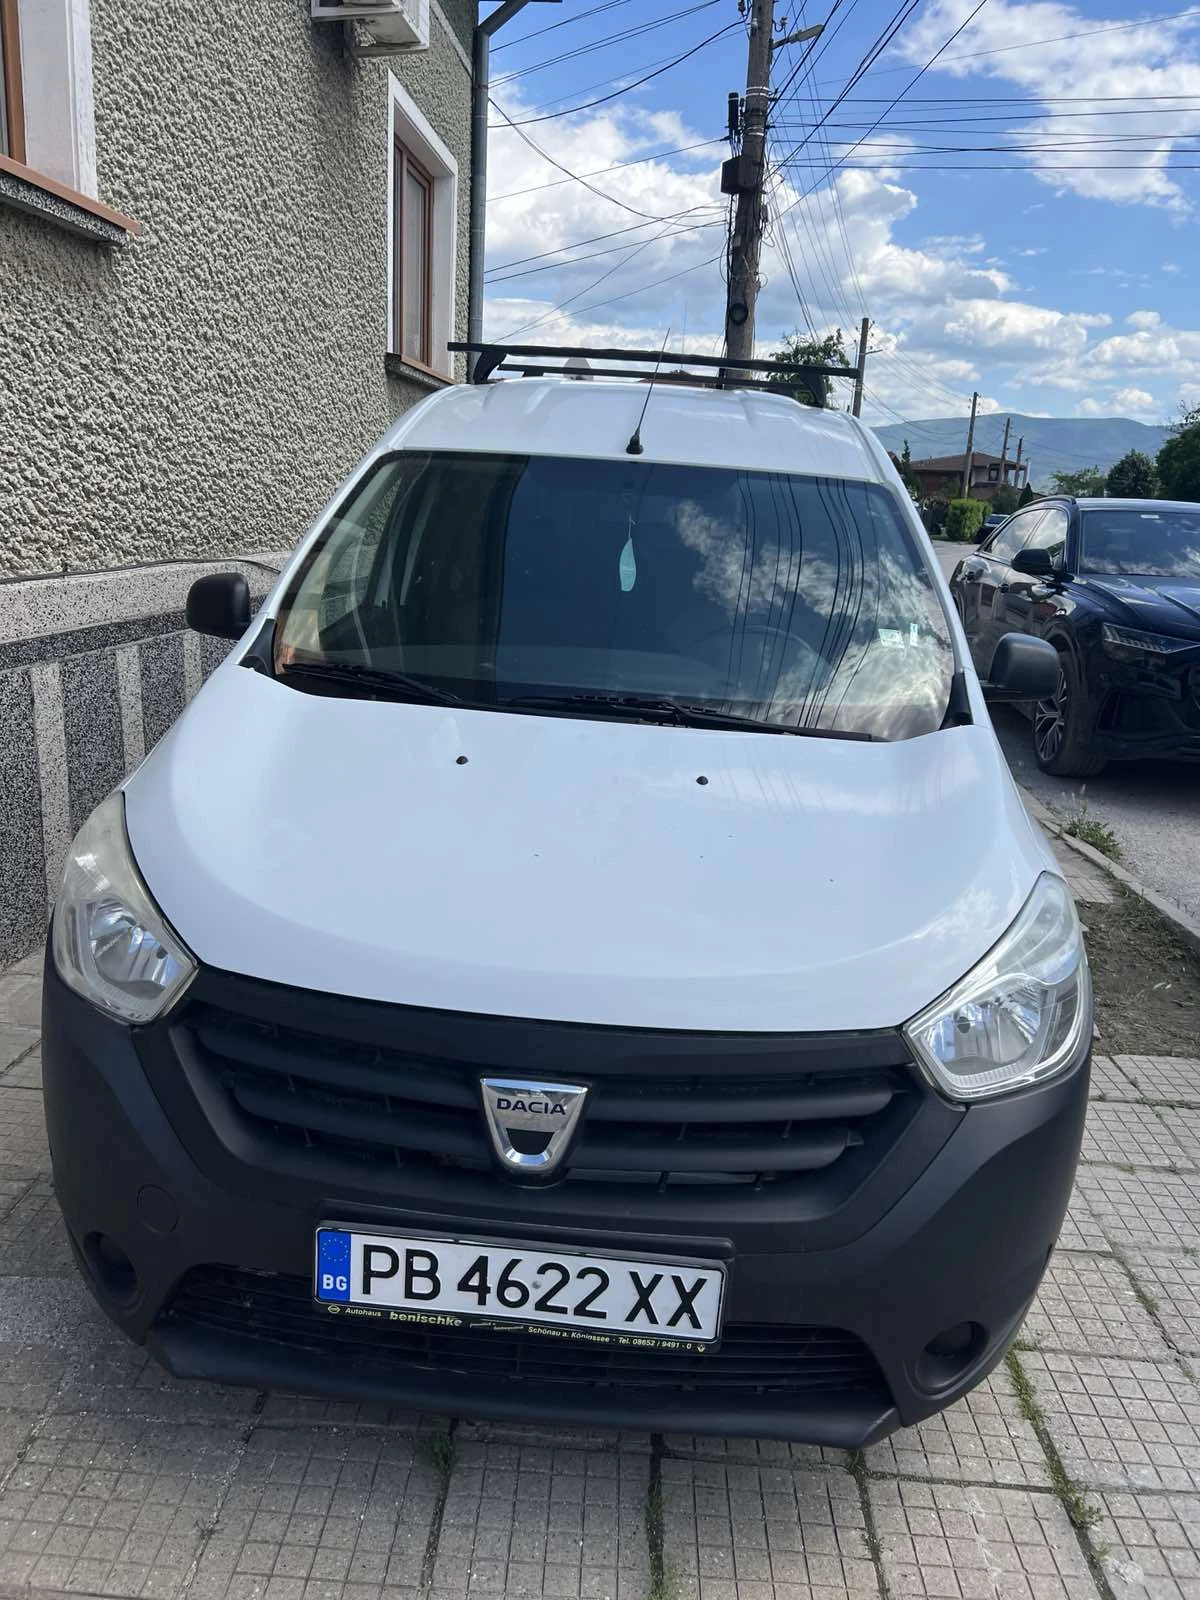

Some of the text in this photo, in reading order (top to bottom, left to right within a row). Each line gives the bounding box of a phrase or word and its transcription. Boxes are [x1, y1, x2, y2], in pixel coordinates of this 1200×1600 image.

[496, 1098, 566, 1115] DACIA
[322, 1273, 348, 1291] BG
[362, 1244, 708, 1329] PB 4622 XX
[345, 1307, 382, 1317] Autohaus
[389, 1311, 463, 1327] benischke
[528, 1326, 561, 1337] Schönau
[619, 1337, 631, 1345] Tel.
